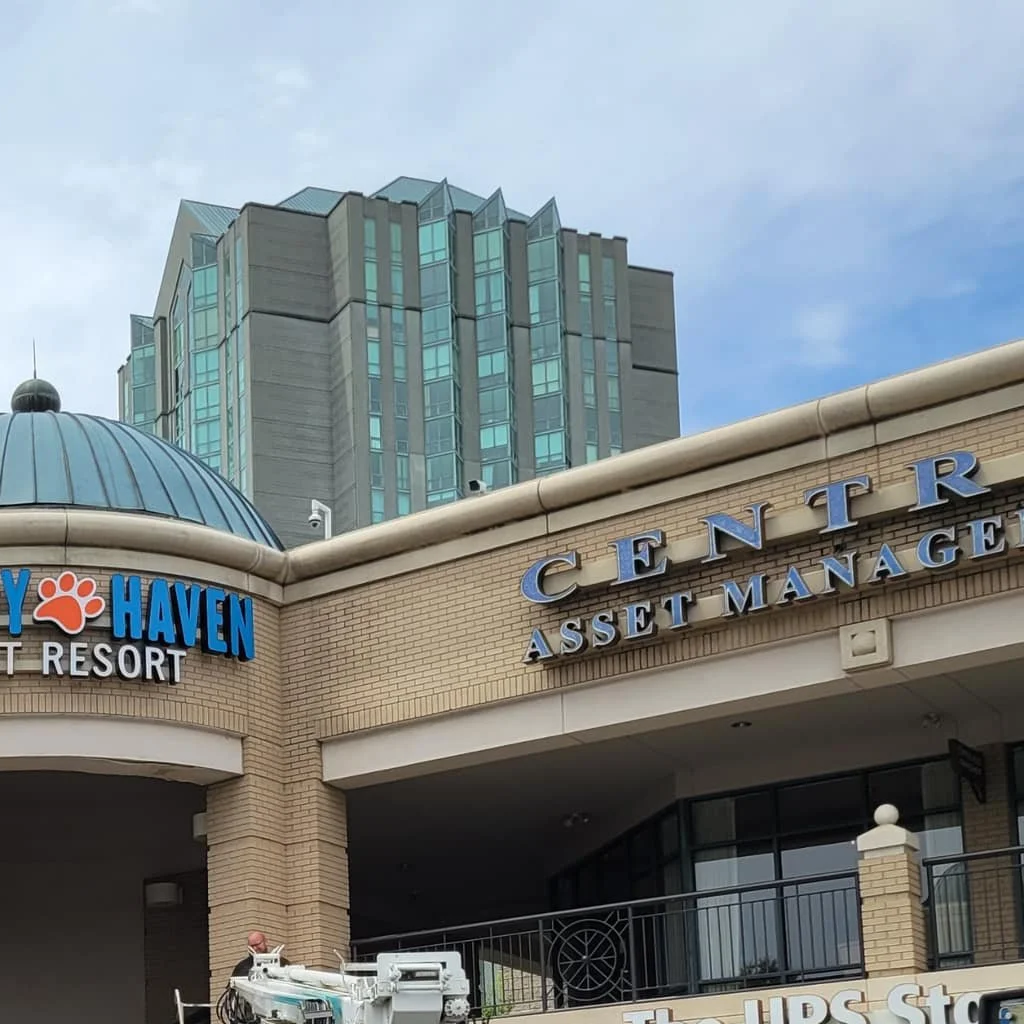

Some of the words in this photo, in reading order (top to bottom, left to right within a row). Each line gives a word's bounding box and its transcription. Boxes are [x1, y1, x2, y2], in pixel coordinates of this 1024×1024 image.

[520, 450, 992, 604] CENTR
[111, 573, 255, 660] HAVEN
[522, 591, 693, 664] ASSET
[42, 641, 187, 684] RESORT
